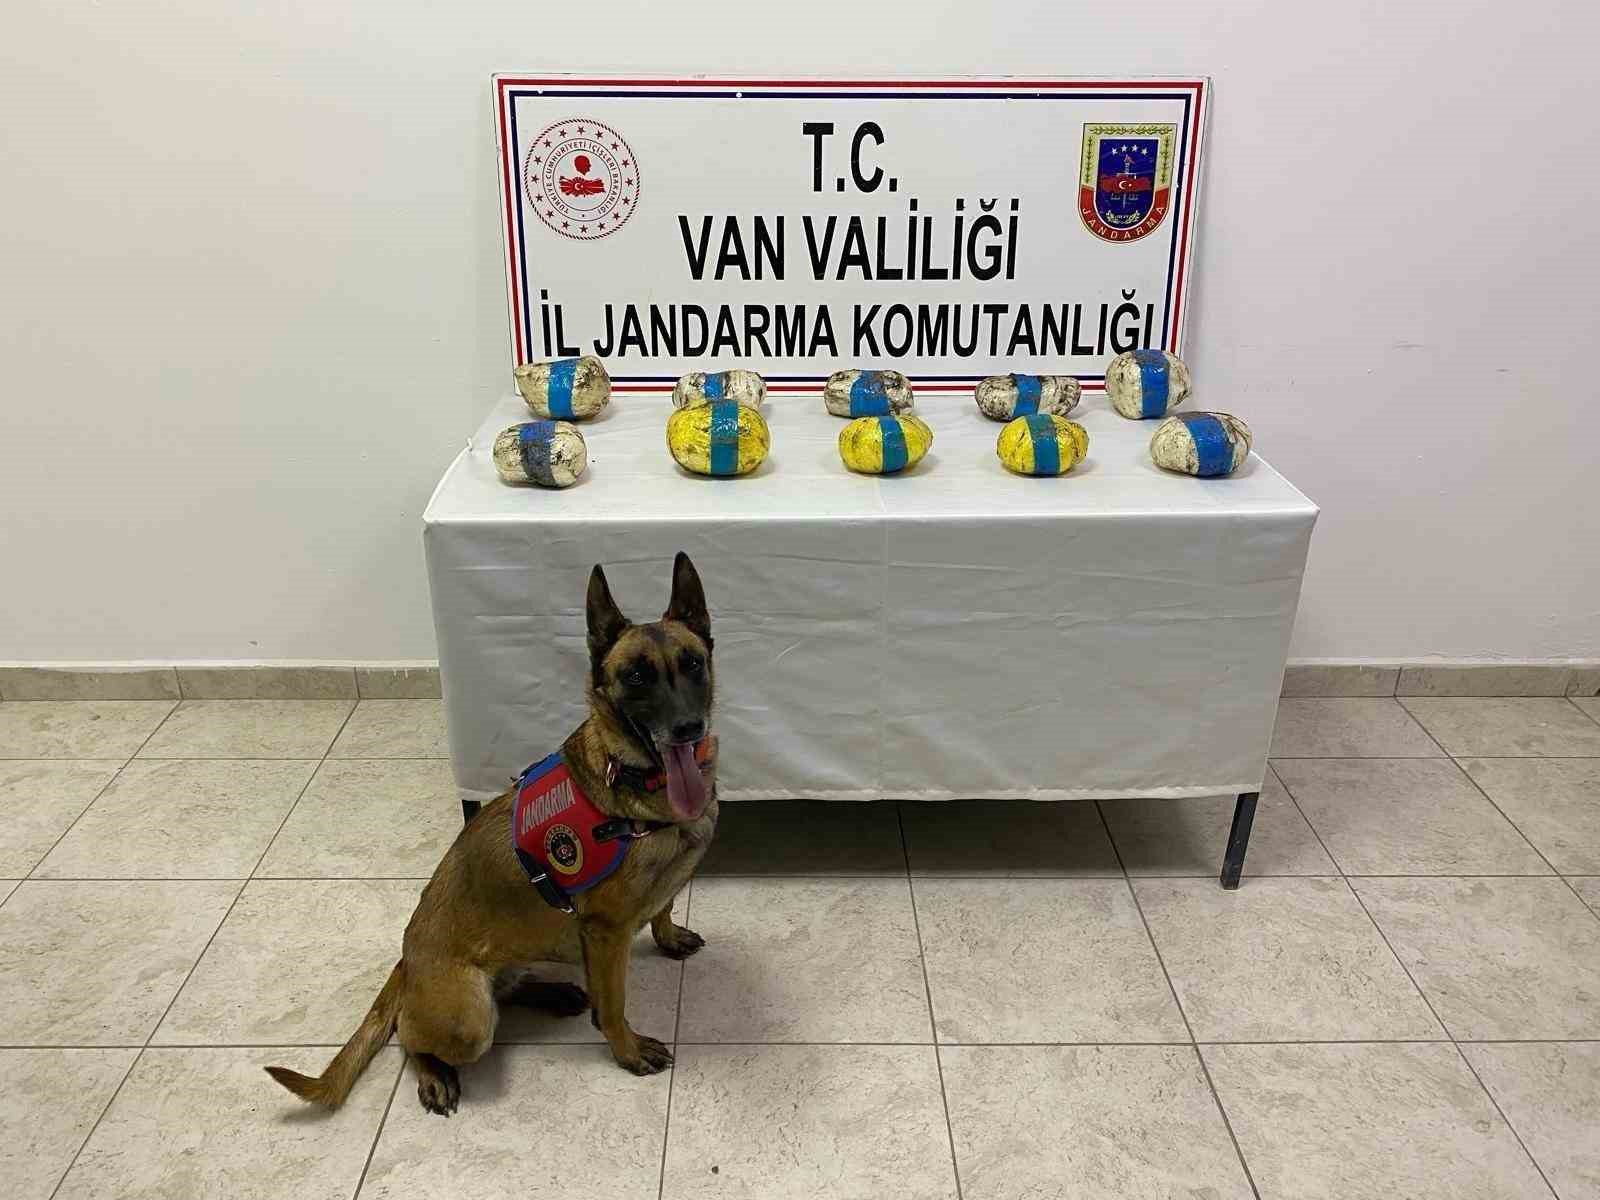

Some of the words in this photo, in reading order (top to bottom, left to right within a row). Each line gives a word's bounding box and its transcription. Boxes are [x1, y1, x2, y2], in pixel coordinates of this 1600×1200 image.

[803, 122, 897, 193] T.C.
[678, 215, 784, 281] VAN
[803, 198, 1020, 281] VALİLİĞİ
[1082, 207, 1165, 239] JANDARMA
[541, 290, 581, 357] İL
[594, 304, 833, 358] JANDARMA
[854, 289, 1155, 357] KOMUTANLIĞI
[521, 777, 576, 835] JANDARMA
